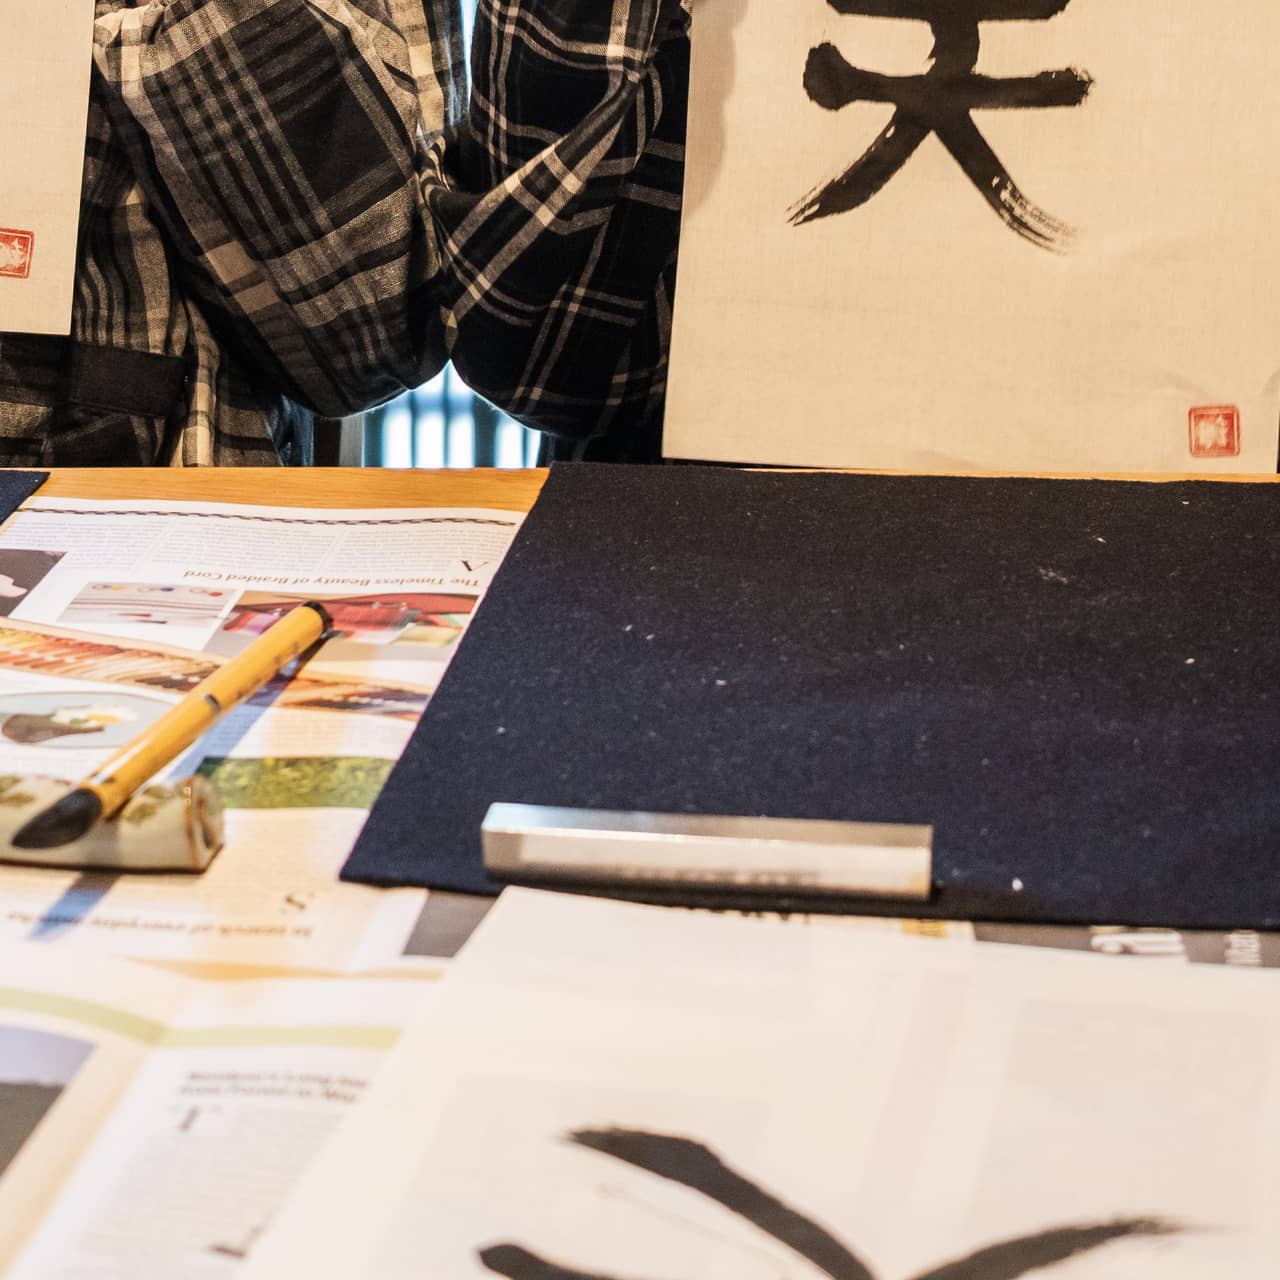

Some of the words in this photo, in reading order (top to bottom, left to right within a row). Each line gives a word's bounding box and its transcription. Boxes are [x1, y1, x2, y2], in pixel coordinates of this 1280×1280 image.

[183, 568, 223, 581] Cord
[225, 572, 289, 584] Braided
[313, 575, 370, 586] Beauty
[375, 577, 444, 586] Timeless
[449, 577, 480, 587] The
